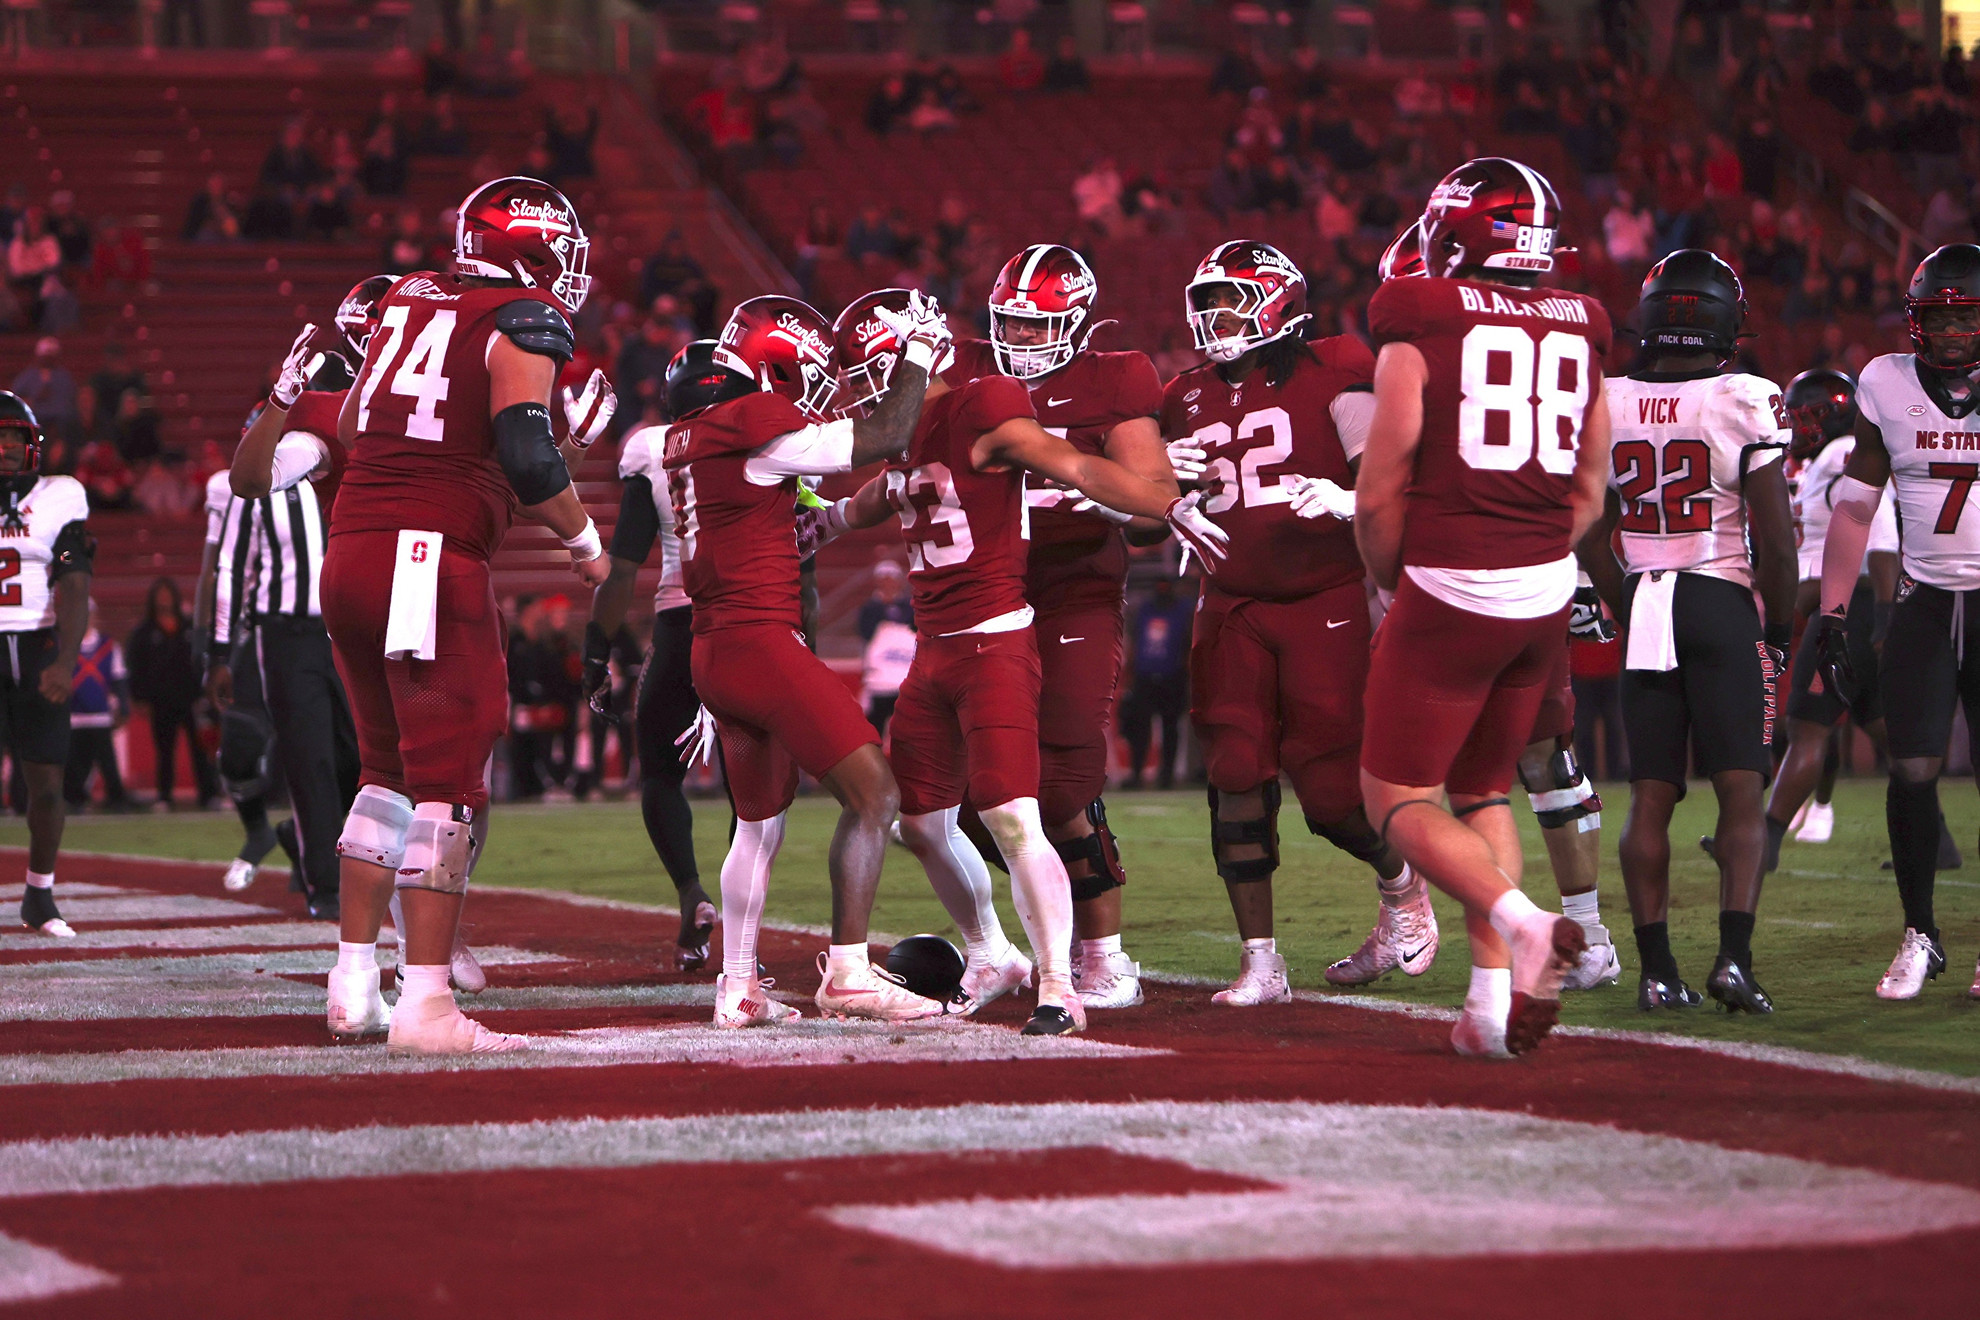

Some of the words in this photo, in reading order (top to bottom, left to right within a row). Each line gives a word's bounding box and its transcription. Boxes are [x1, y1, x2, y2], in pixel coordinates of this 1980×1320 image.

[508, 198, 570, 229] Stanford
[463, 231, 473, 254] 4
[1457, 286, 1589, 324] BLACKBURN
[776, 311, 834, 362] Stanford
[1658, 334, 1679, 344] PACK
[1682, 335, 1704, 346] GOAL
[356, 305, 457, 442] 74
[1459, 324, 1590, 475] 88
[1638, 397, 1680, 424] VICK
[1192, 406, 1300, 514] 62
[1915, 430, 1939, 449] NC
[1611, 439, 1712, 534] 22
[1928, 462, 1979, 534] 7
[0, 547, 22, 606] 2
[1755, 640, 1777, 745] WOLFPACK
[737, 998, 760, 1018] NIKE
